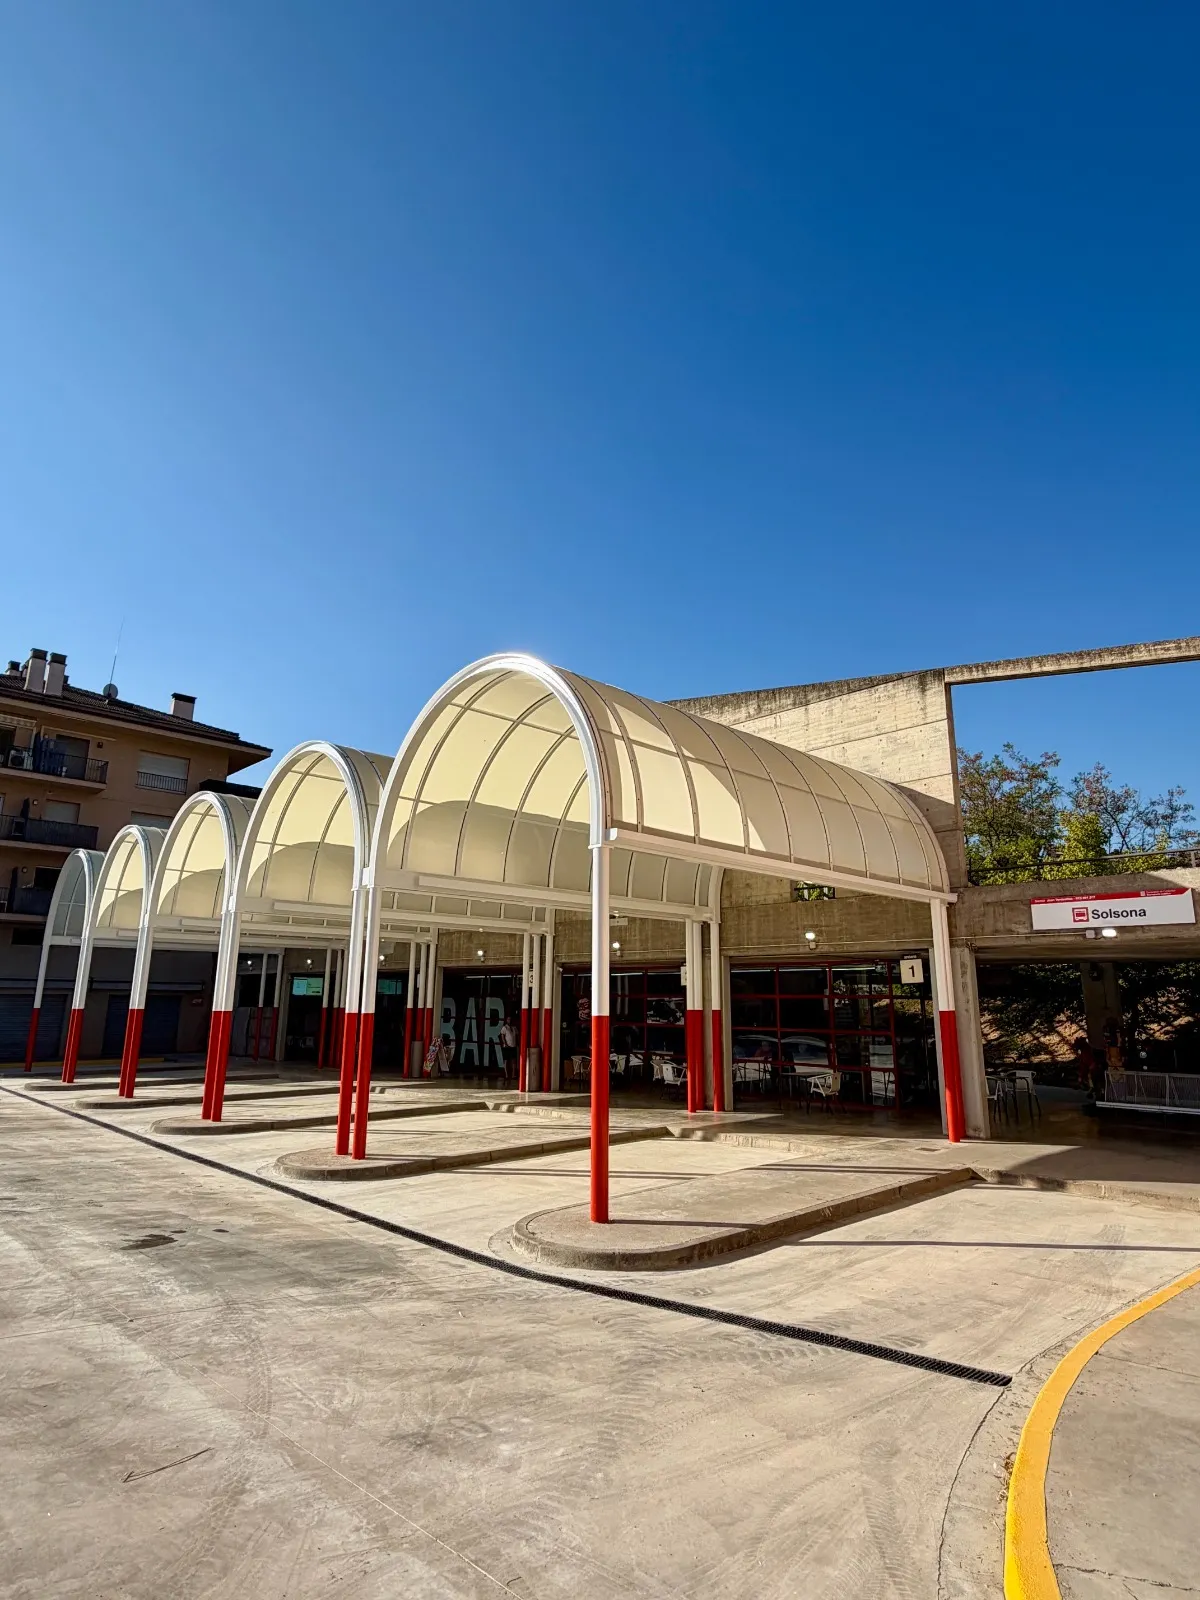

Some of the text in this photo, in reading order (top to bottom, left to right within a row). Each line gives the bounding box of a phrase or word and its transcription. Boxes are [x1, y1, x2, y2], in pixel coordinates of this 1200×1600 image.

[1091, 907, 1147, 920] Solsona
[908, 964, 915, 978] 1
[440, 997, 505, 1068] BAR
